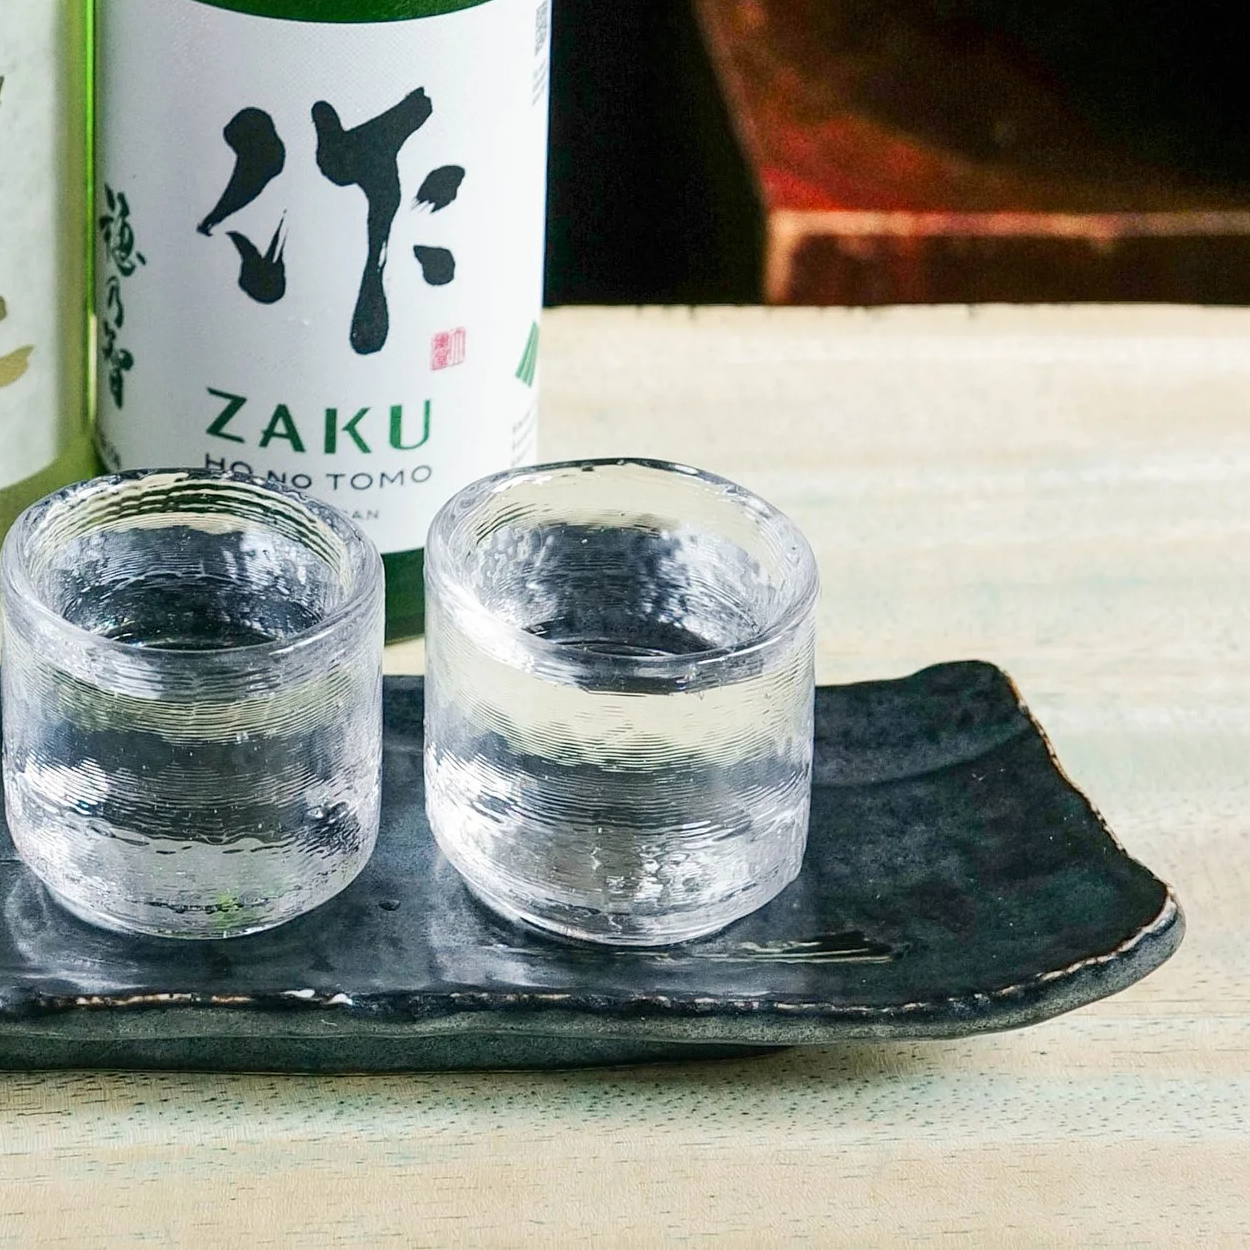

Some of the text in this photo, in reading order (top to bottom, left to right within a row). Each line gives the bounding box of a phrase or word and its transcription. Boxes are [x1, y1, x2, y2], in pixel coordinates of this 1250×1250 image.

[196, 86, 466, 355] 作
[206, 386, 432, 455] ZAKU
[267, 469, 312, 489] NO
[326, 465, 432, 491] TOMO
